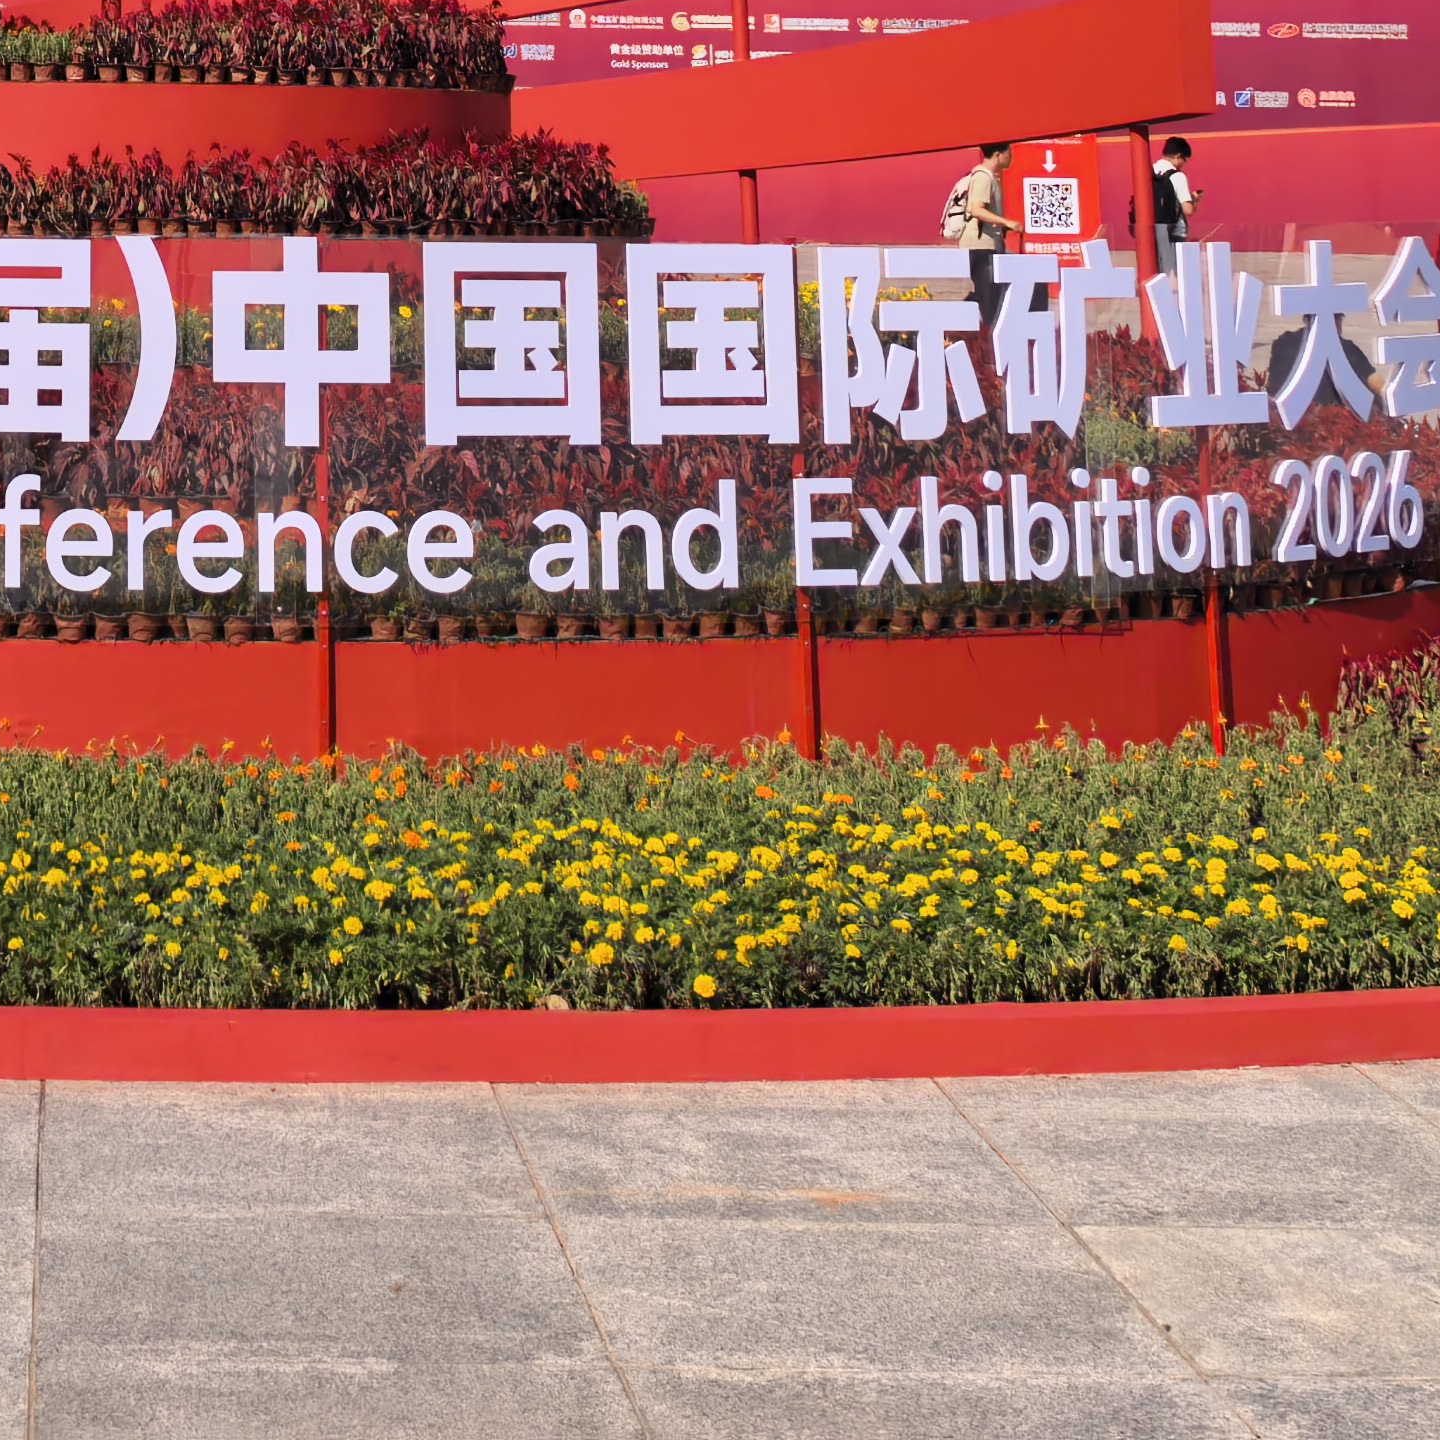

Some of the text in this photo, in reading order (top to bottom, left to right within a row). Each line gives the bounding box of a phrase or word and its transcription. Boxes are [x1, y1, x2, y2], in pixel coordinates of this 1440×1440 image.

[611, 60, 668, 69] Gold Sponsors
[528, 478, 739, 593] and
[793, 468, 1253, 587] Exhibition
[1271, 449, 1424, 563] 2026
